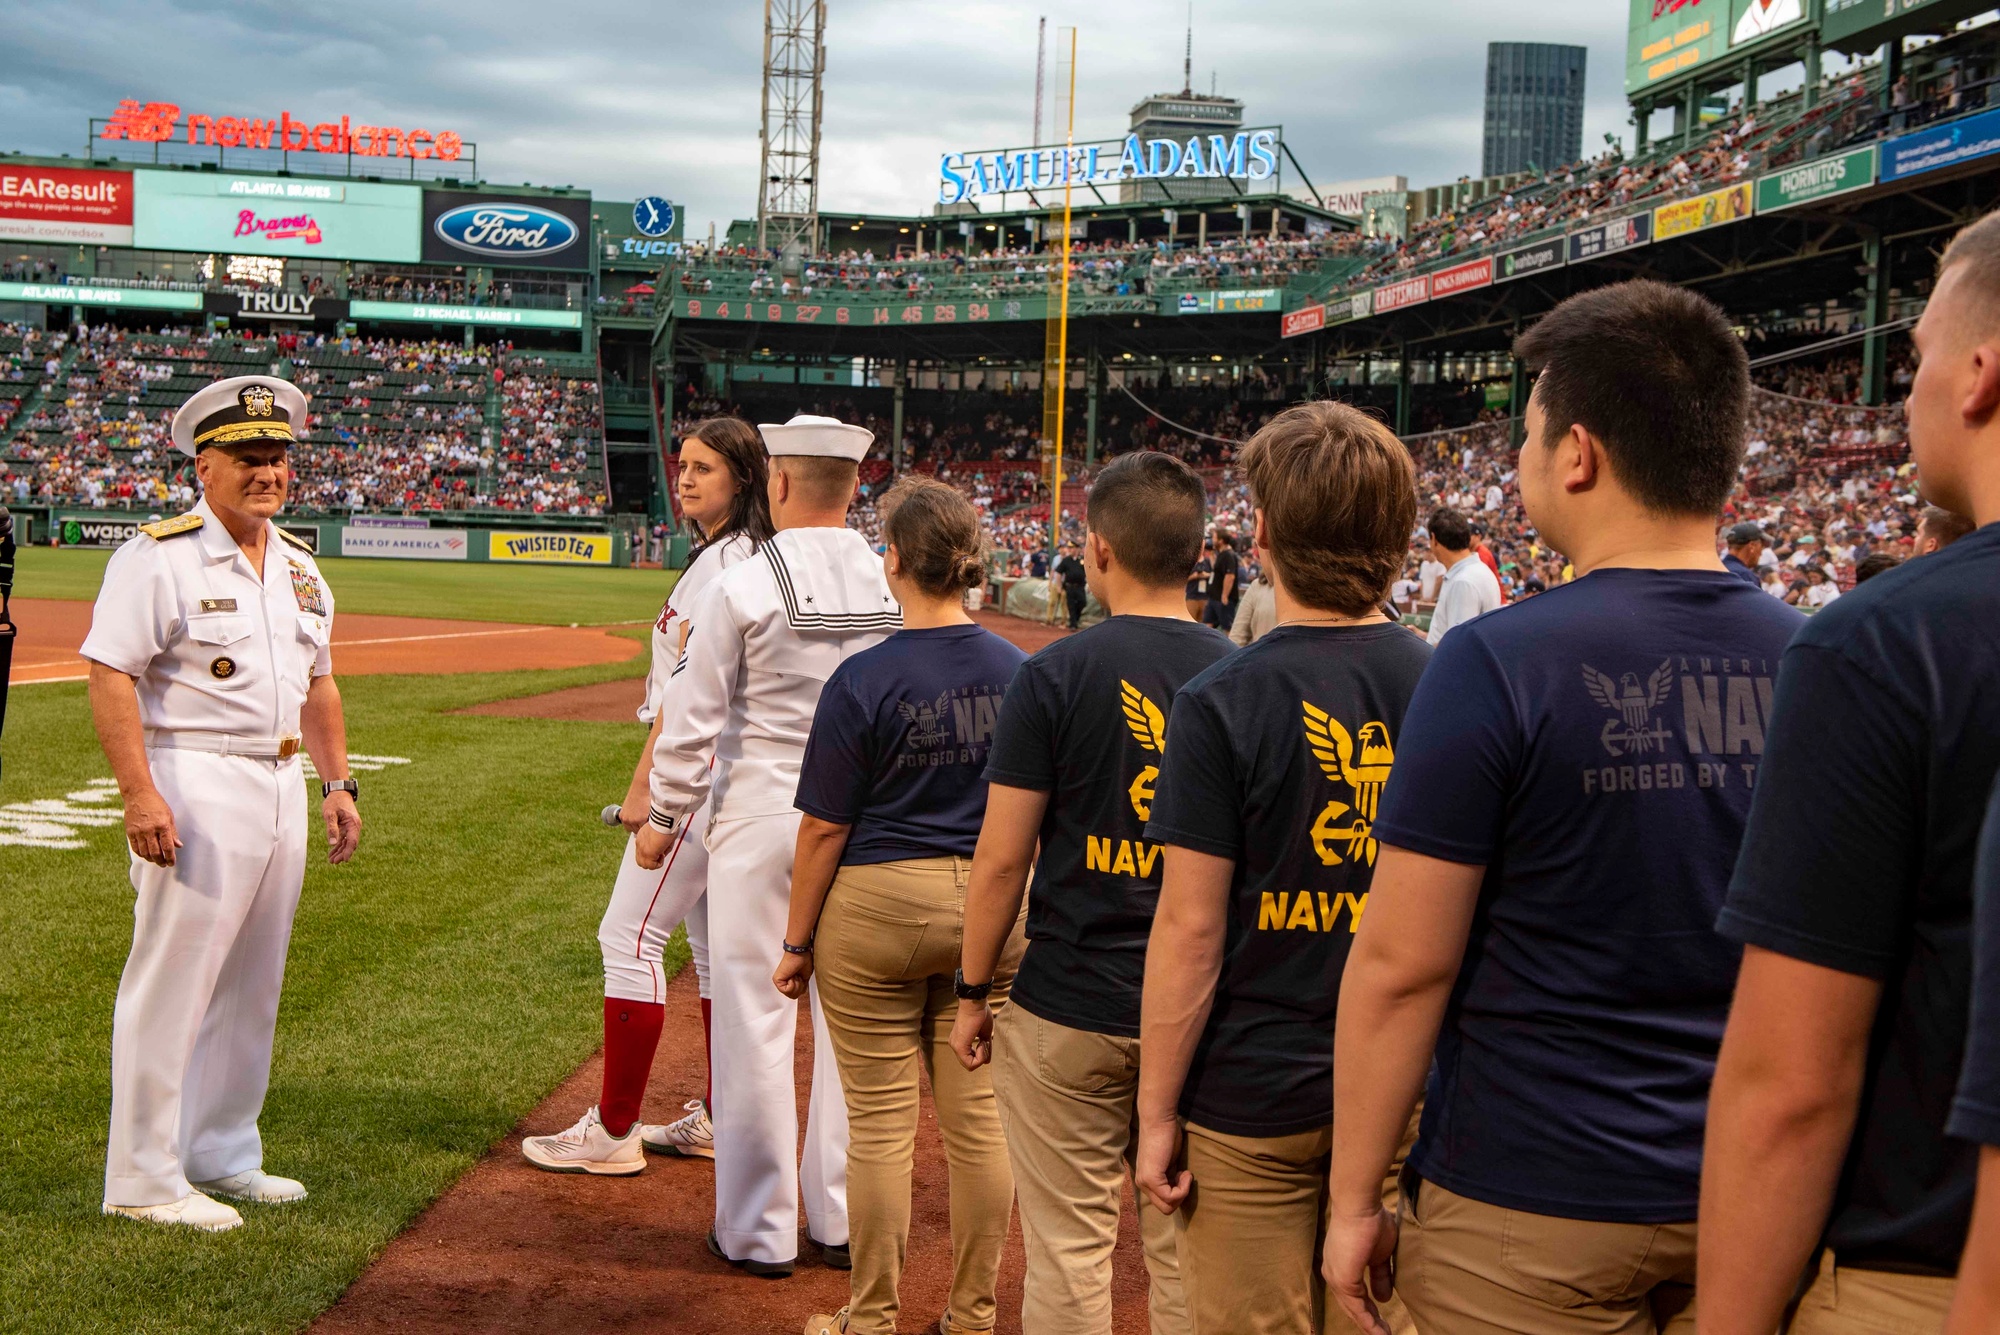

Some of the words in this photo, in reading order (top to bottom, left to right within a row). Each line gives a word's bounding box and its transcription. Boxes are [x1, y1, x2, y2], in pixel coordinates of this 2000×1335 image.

[188, 113, 276, 149] new
[281, 110, 462, 162] balance
[939, 145, 1109, 205] SAMUEL
[1117, 131, 1276, 181] ADAMS
[1780, 158, 1846, 194] HORNITOS
[0, 175, 117, 202] EAResult
[230, 181, 284, 195] ATLANTA
[287, 184, 331, 198] BRAVES
[234, 209, 308, 238] Braves
[463, 210, 550, 248] Ford
[1514, 248, 1554, 270] wahlburgers
[22, 286, 76, 299] ATLANTA
[78, 289, 121, 302] BRAVES
[238, 292, 315, 313] TRULY
[1375, 278, 1427, 310] CRAFTSMAN
[413, 307, 425, 318] 23
[428, 308, 473, 320] MICHAEL
[688, 300, 702, 317] 9
[716, 302, 730, 318] 4
[744, 303, 752, 319] 1
[796, 305, 821, 322] 27
[836, 307, 849, 323] 6
[873, 307, 890, 324] 14
[901, 306, 923, 323] 45
[968, 303, 990, 320] 34
[345, 538, 373, 547] BANK
[377, 539, 390, 547] OF
[393, 540, 440, 549] AMERICA
[506, 536, 566, 556] TWISTED
[568, 537, 594, 559] TEA
[897, 749, 955, 769] FORGED
[960, 747, 977, 764] BY
[1583, 763, 1684, 794] FORGED
[1699, 763, 1727, 788] BY
[1086, 834, 1165, 879] NAV
[1258, 890, 1370, 934] NAVY
